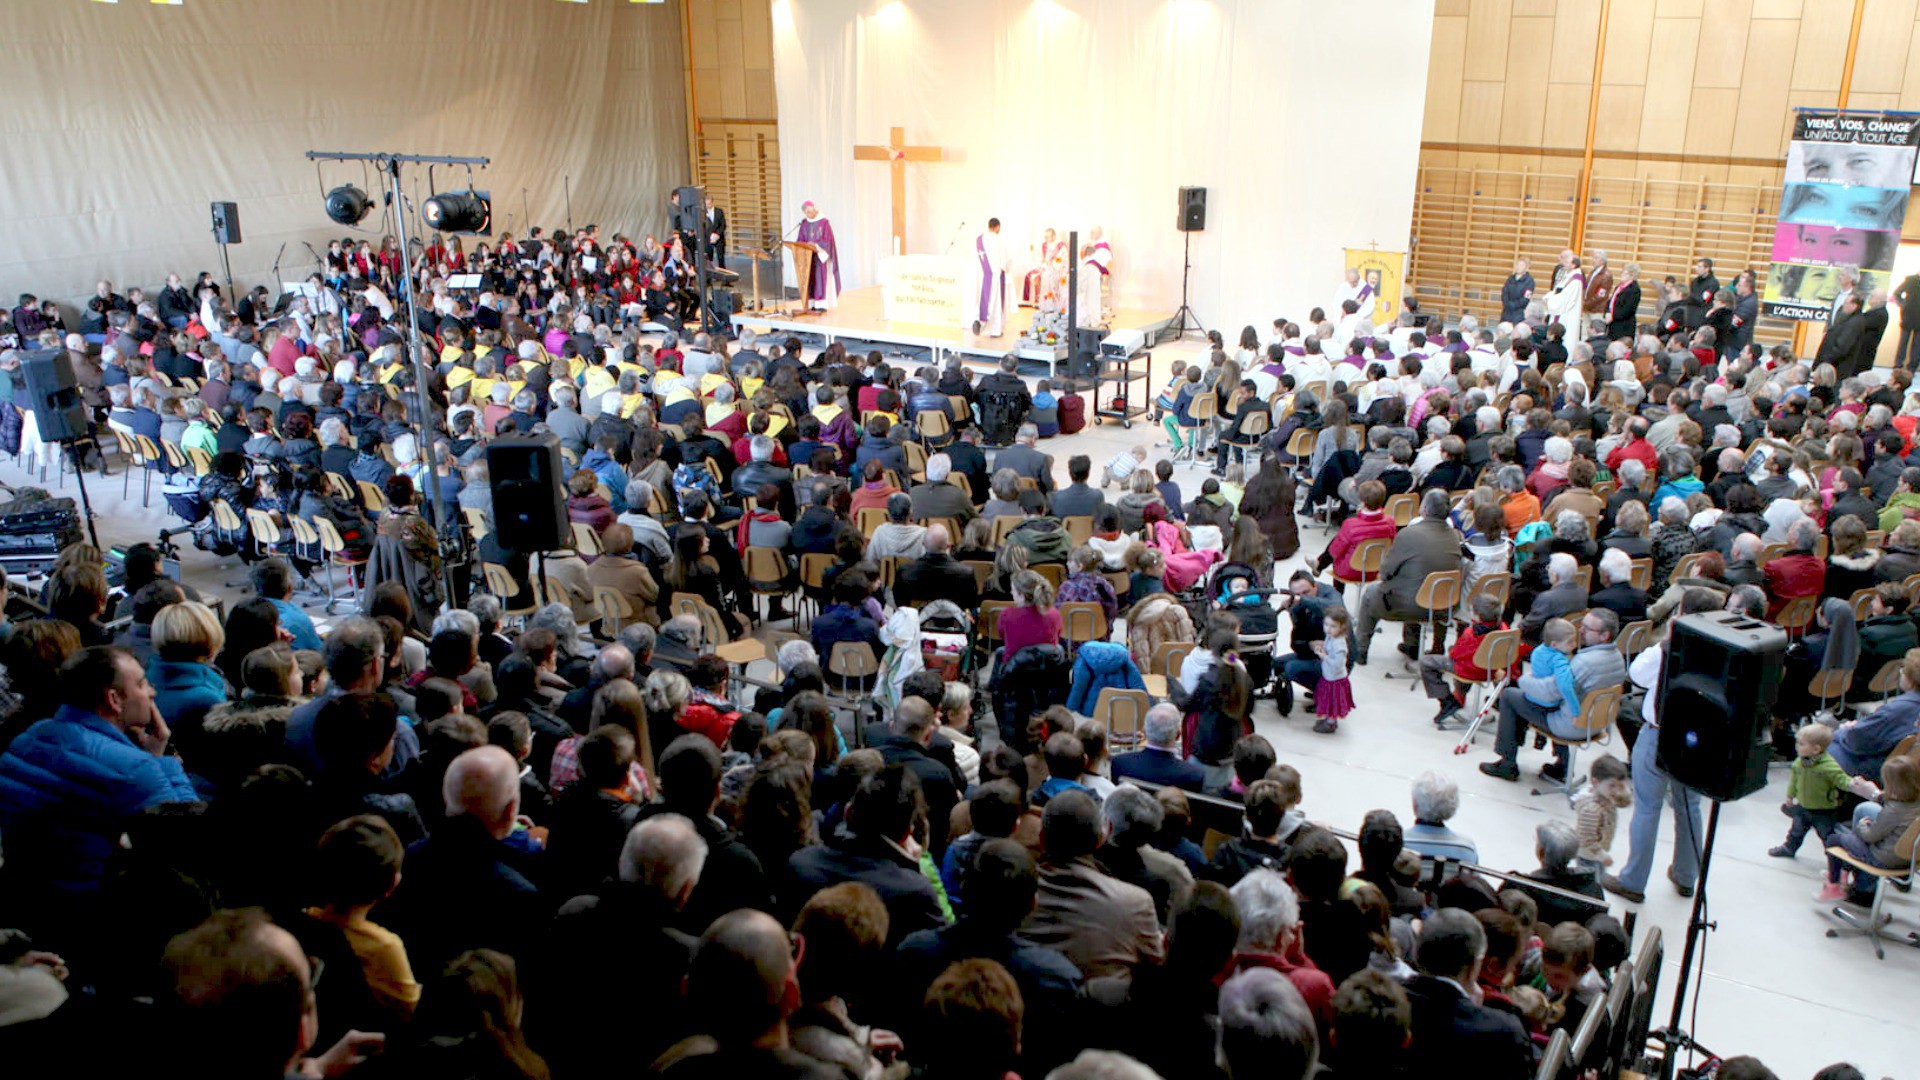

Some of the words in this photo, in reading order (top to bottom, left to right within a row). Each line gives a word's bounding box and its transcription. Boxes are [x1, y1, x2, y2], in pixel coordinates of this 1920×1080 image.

[1806, 118, 1837, 130] VIENS,
[1840, 119, 1865, 131] VOIS,
[1868, 121, 1911, 133] CHANGE
[1804, 130, 1819, 139] UN
[1820, 131, 1850, 141] ATOUT
[1862, 132, 1885, 142] TOUT
[1773, 305, 1813, 319] L'ACTION
[1815, 309, 1829, 320] CA
